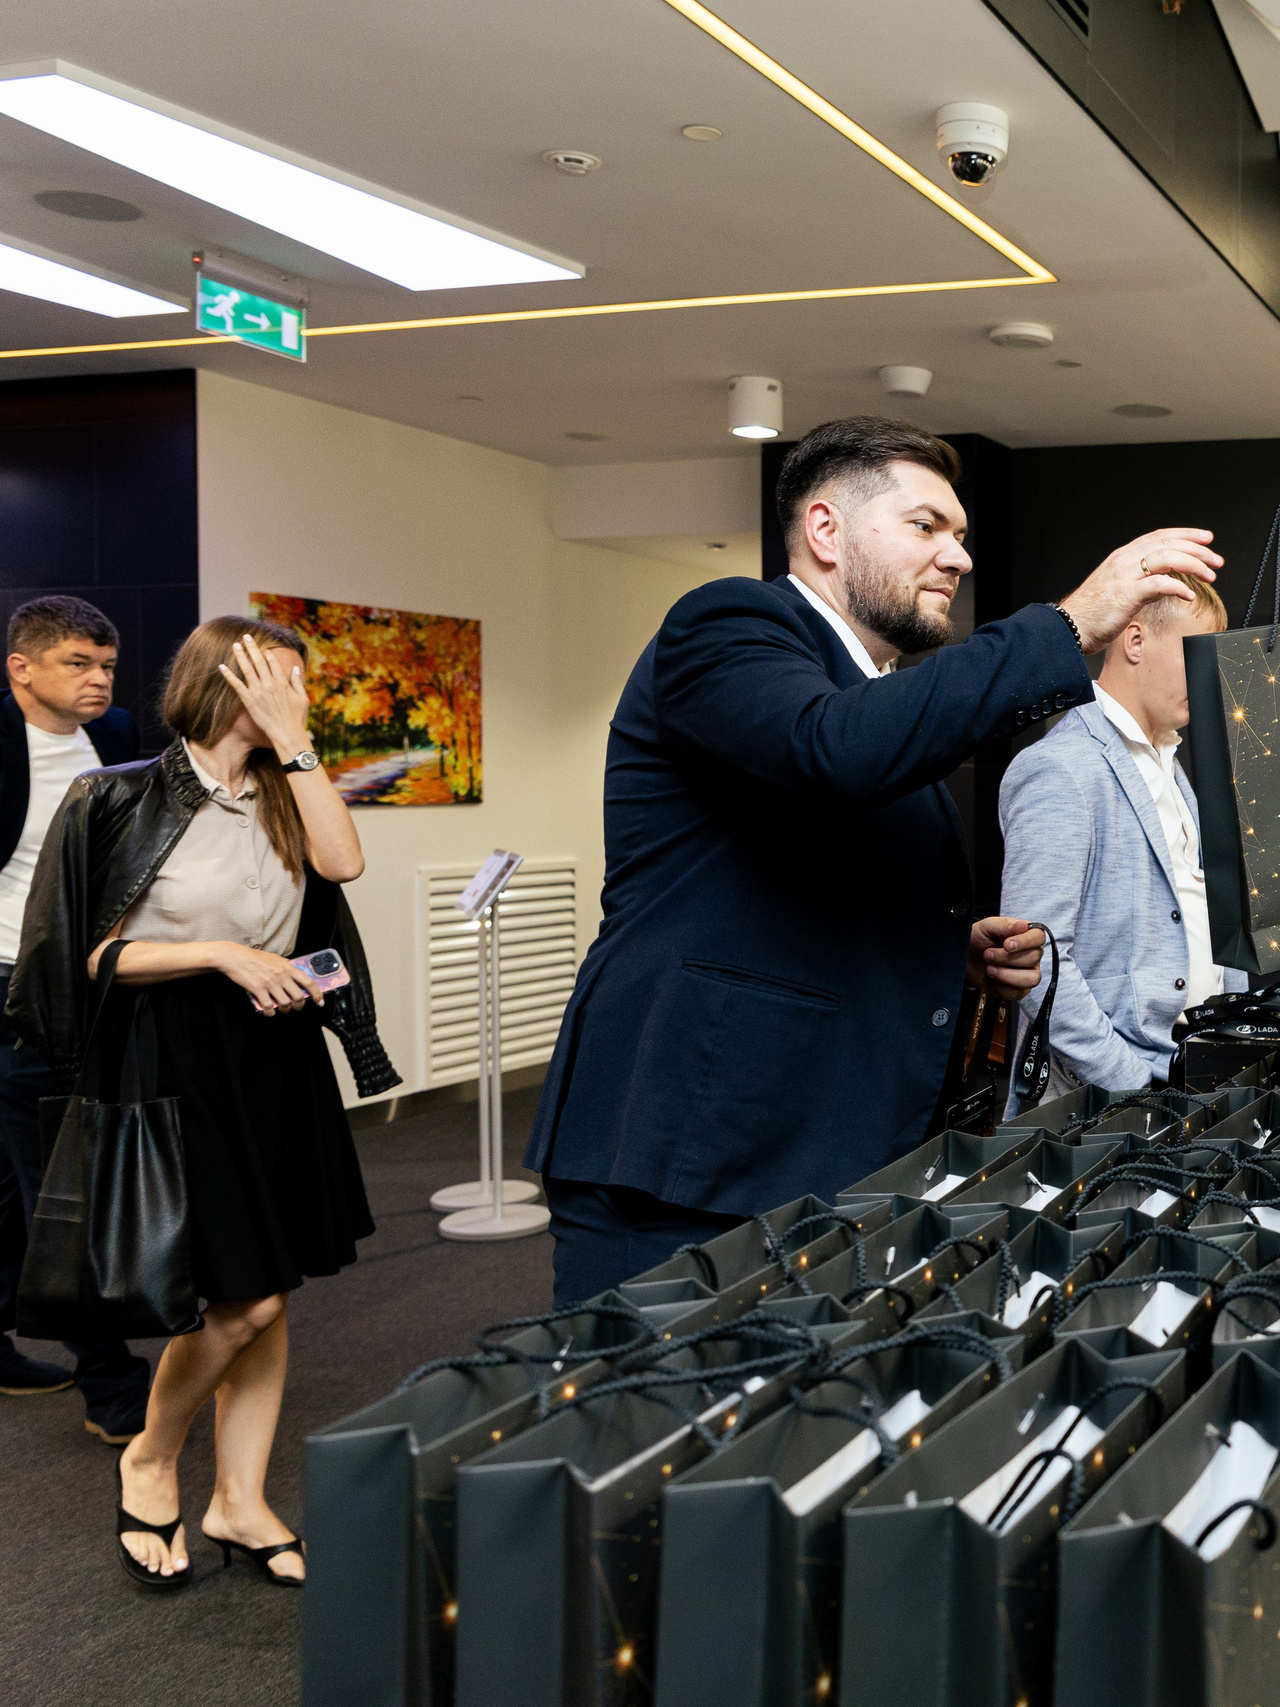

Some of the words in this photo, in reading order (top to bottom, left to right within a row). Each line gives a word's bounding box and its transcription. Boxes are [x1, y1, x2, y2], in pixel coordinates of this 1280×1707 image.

[1202, 1008, 1215, 1017] LADA
[1257, 1026, 1279, 1034] LADA
[1029, 1035, 1040, 1056] LADA
